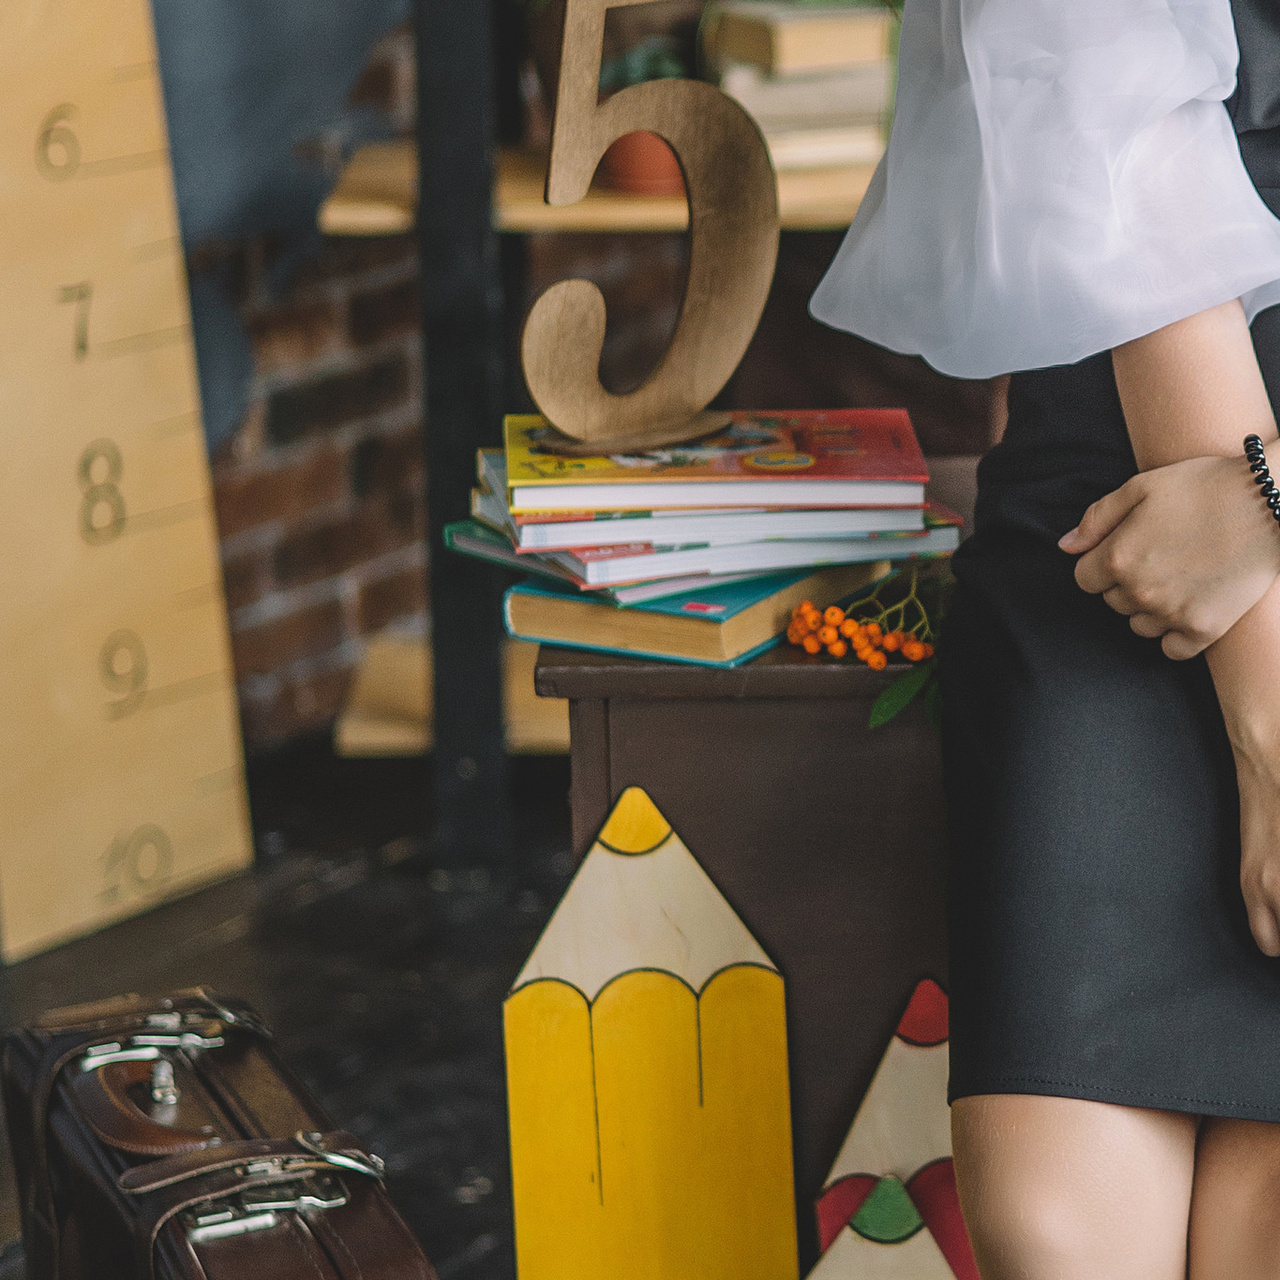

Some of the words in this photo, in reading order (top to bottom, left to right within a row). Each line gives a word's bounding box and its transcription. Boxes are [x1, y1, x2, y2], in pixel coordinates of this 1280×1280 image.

[35, 102, 83, 183] 6
[56, 281, 93, 364] 7
[78, 437, 128, 546] 8
[98, 631, 149, 720] 9
[97, 823, 174, 907] 10
